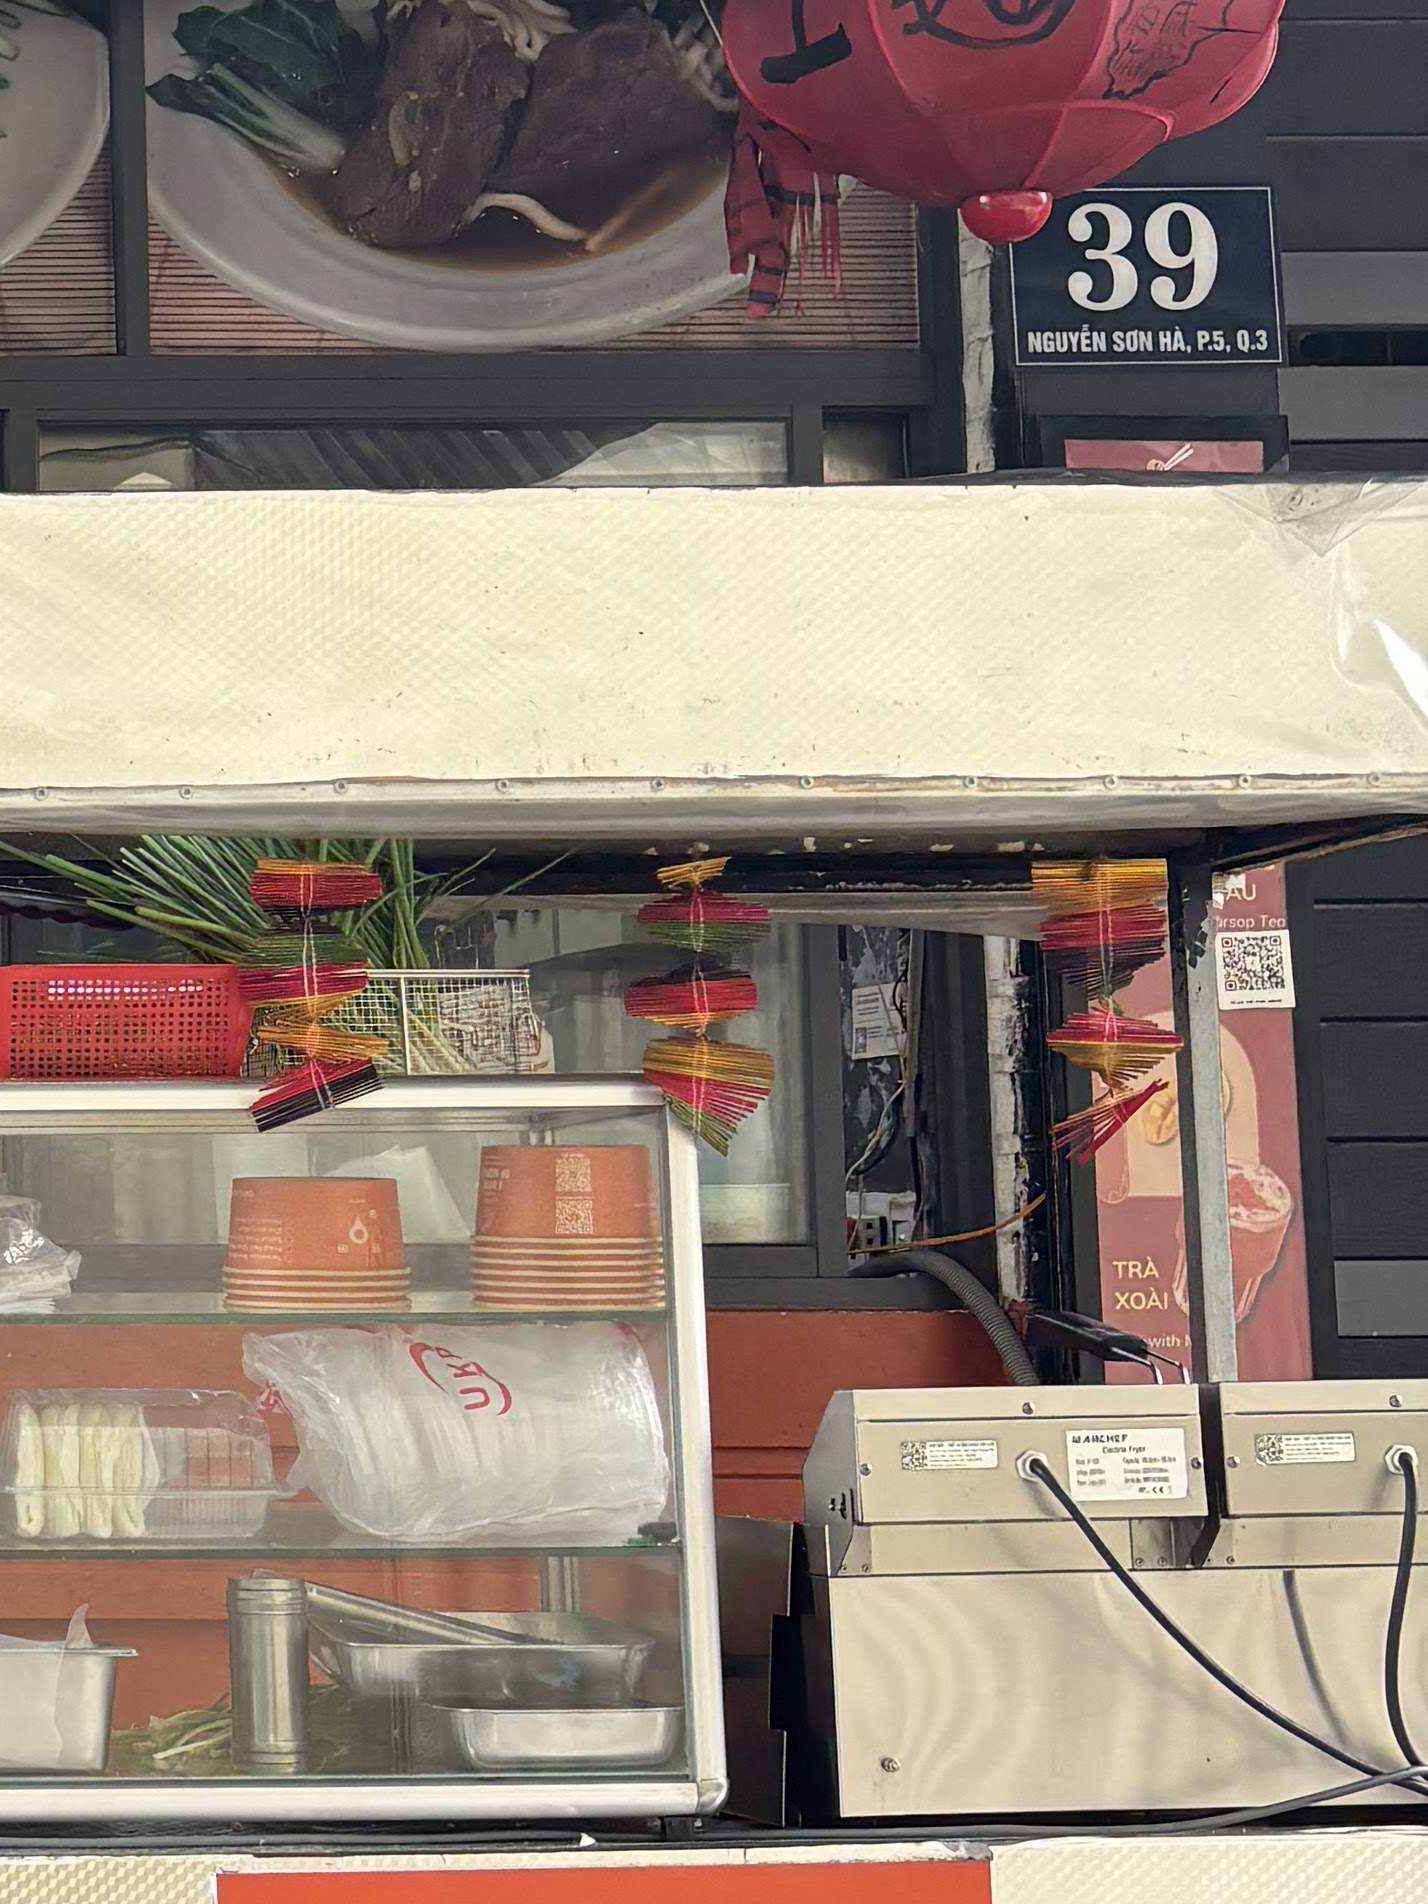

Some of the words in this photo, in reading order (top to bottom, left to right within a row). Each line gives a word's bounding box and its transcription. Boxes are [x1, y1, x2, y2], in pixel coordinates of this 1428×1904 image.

[1067, 201, 1218, 312] 39
[1027, 323, 1107, 354] NGUYỄN
[1111, 330, 1153, 353] SƠN
[1157, 326, 1192, 356] HÀ,
[1196, 330, 1232, 356] P.5,
[1235, 329, 1269, 354] Q.3
[1259, 914, 1286, 929] Tea
[1112, 1255, 1159, 1280] TRÀ
[1114, 1282, 1168, 1311] XOÀI
[1148, 1333, 1182, 1348] with
